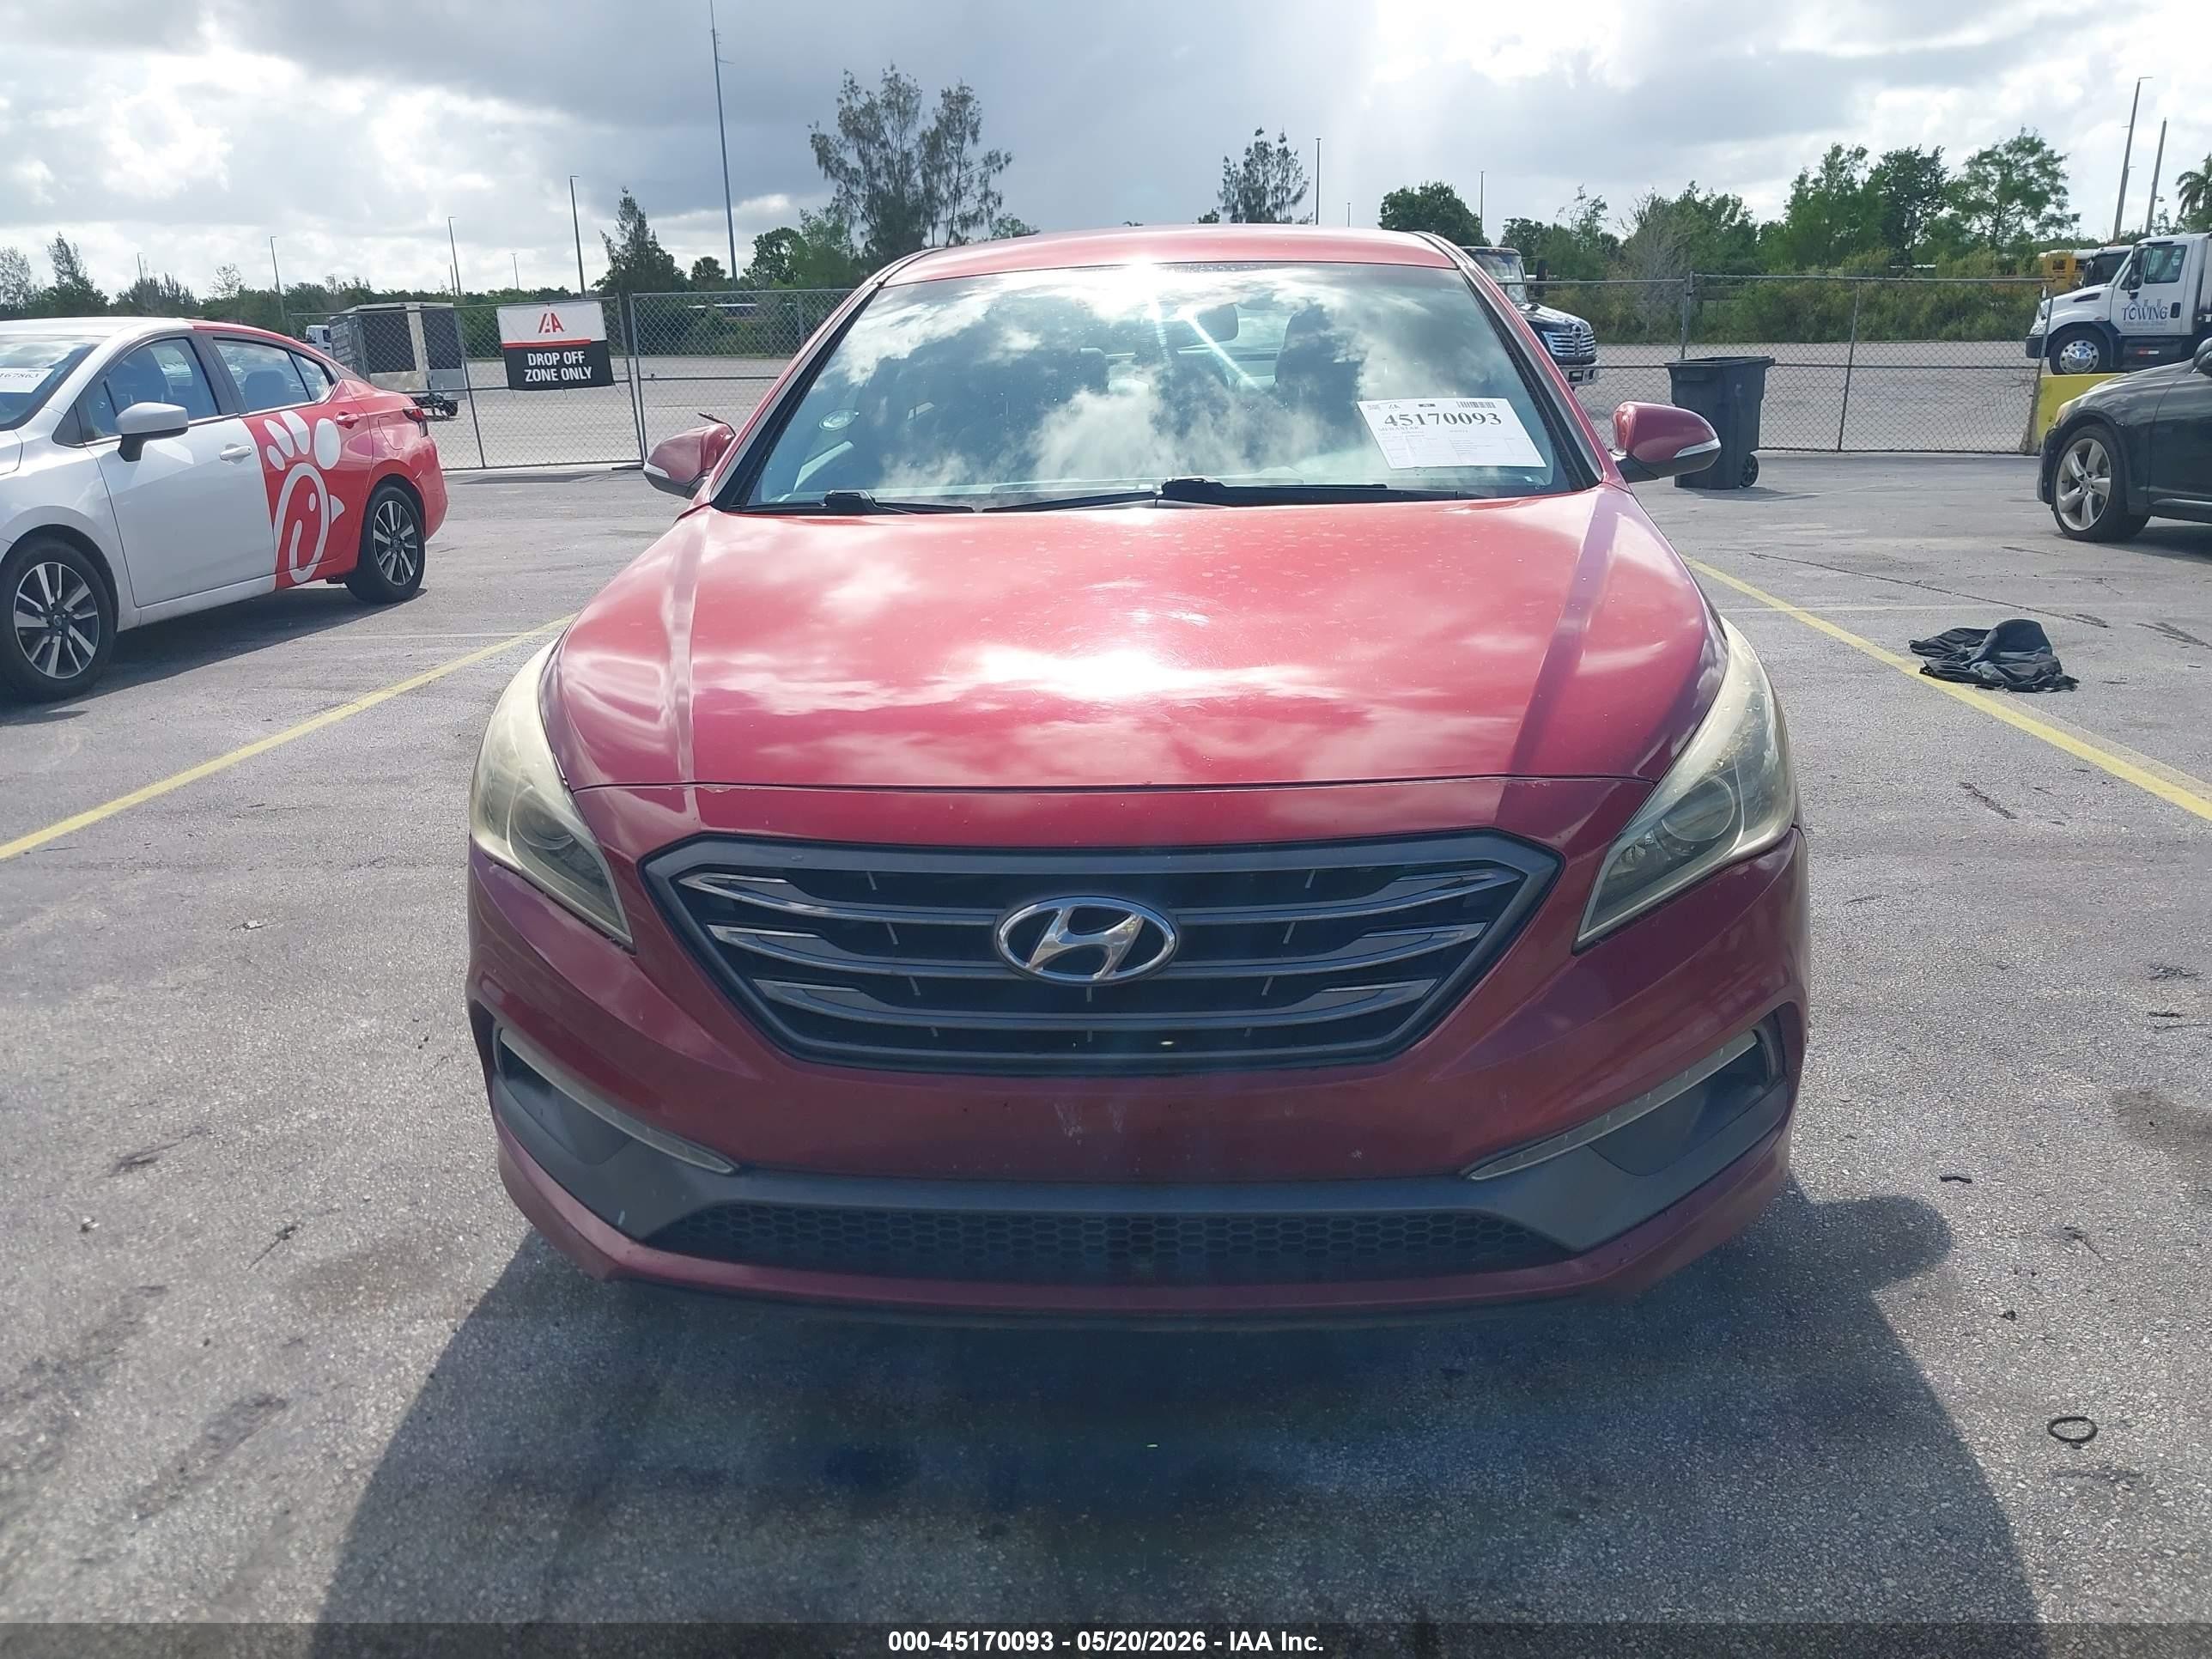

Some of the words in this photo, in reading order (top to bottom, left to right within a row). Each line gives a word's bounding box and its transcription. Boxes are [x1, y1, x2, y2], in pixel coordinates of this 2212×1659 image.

[2122, 306, 2168, 321] TOWING
[527, 352, 561, 367] DROP
[563, 350, 586, 365] OFF
[524, 368, 558, 382] ZONE
[561, 366, 592, 381] ONLY
[1384, 412, 1503, 427] 45170093
